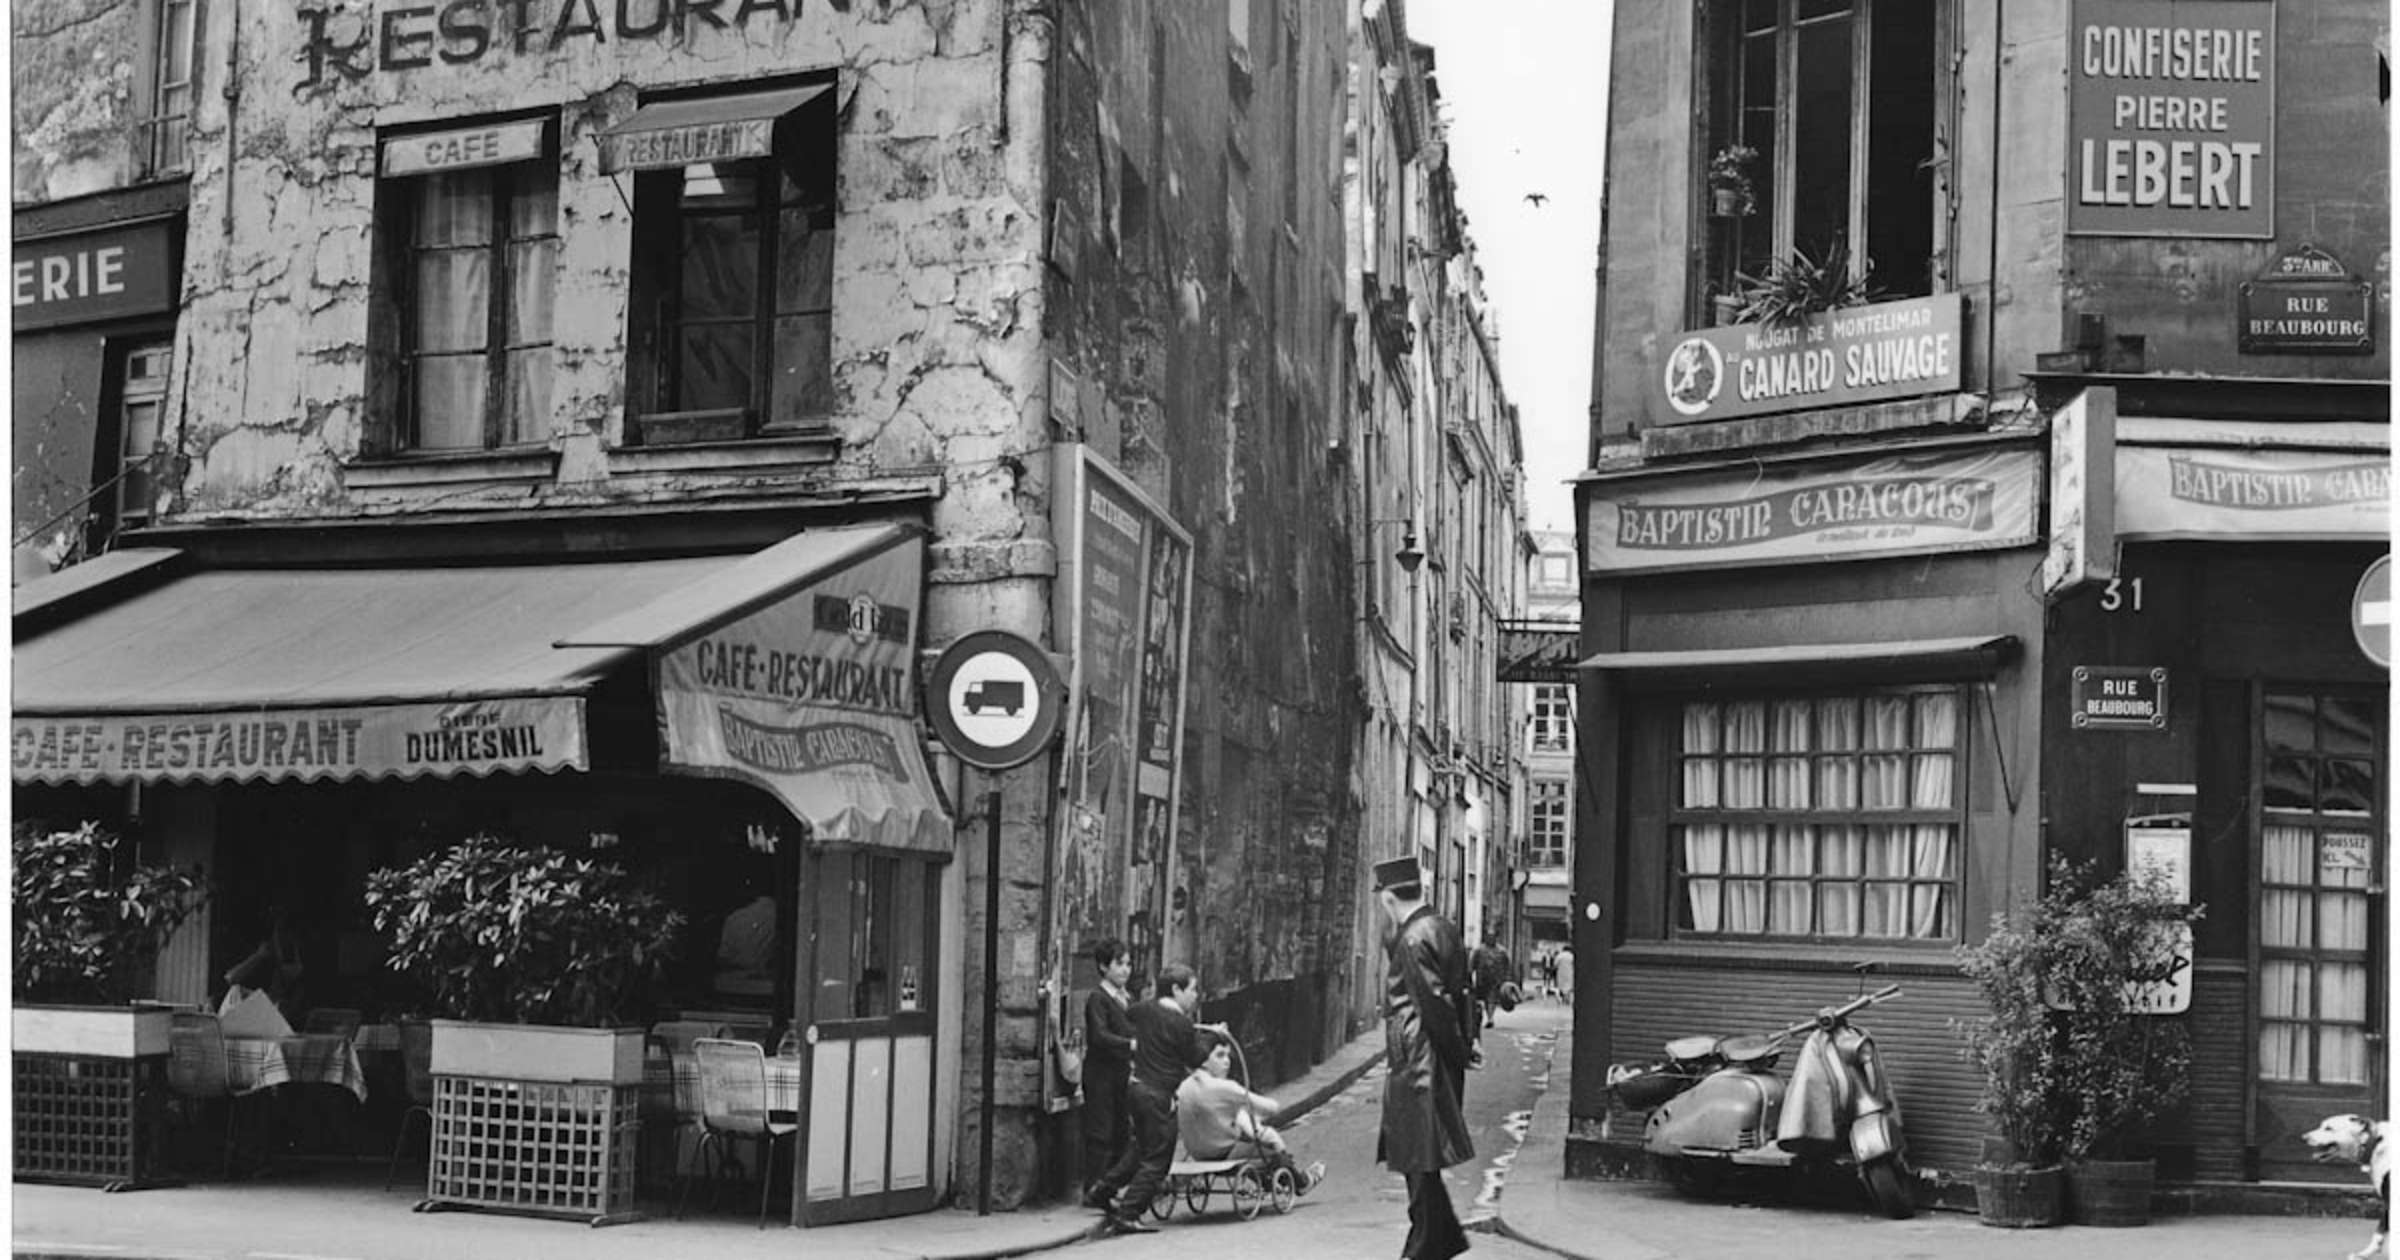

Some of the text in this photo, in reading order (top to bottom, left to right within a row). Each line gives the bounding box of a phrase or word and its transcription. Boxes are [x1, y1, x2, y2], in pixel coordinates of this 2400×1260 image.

[291, 0, 891, 97] RESTAURA
[2083, 25, 2262, 81] CONFISERIE
[2114, 95, 2228, 131] PIERRE
[2080, 138, 2262, 209] LEBERT
[14, 247, 125, 307] ERIE
[2286, 297, 2329, 313] RUE
[1807, 325, 1825, 343] DE
[2250, 319, 2366, 336] BEAUBOURG
[1739, 347, 1835, 402] CANARD
[1845, 333, 1951, 389] SAUVAGE
[2101, 577, 2143, 611] 31
[2103, 679, 2138, 696] RUE
[2087, 699, 2154, 715] BEAUBOURG
[406, 725, 544, 764] DUMESNIL
